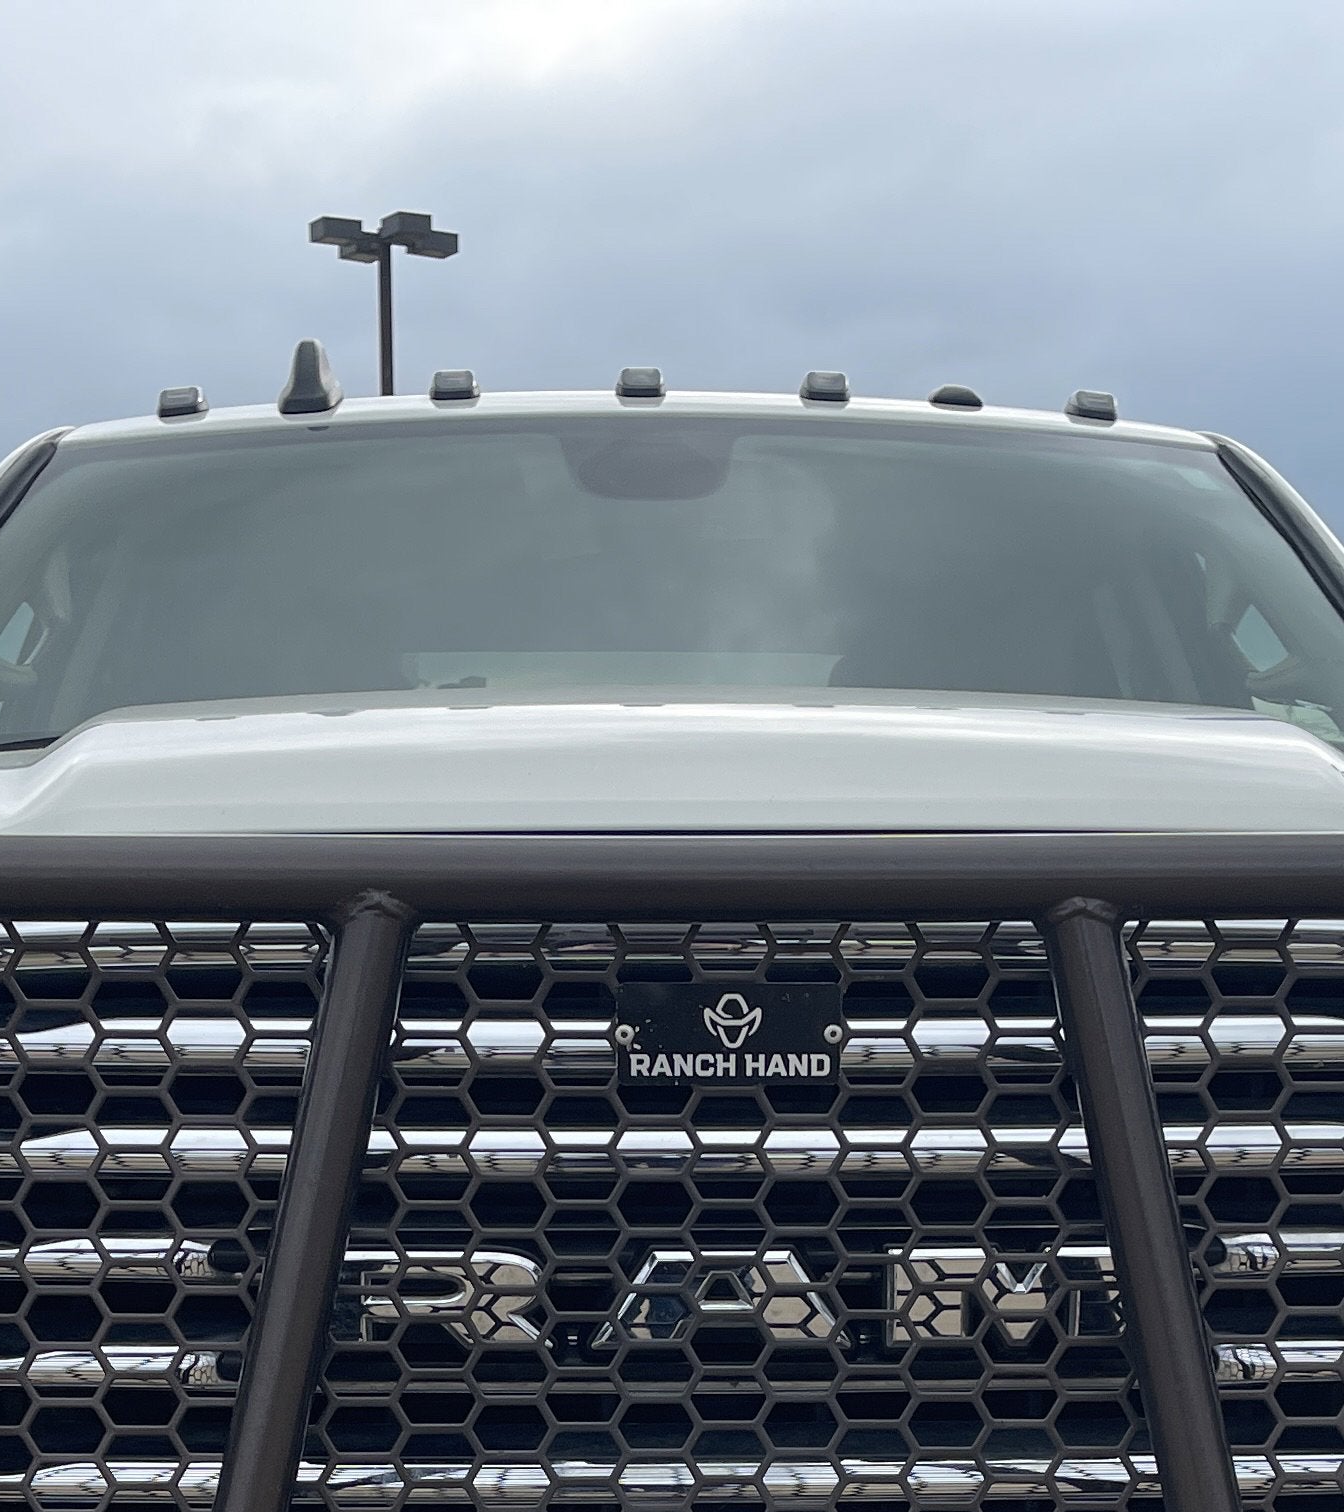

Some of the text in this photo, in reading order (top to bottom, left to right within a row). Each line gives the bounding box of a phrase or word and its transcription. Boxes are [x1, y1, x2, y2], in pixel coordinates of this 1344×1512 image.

[629, 1053, 831, 1077] RANCH HAND
[344, 1244, 1128, 1349] RAM
